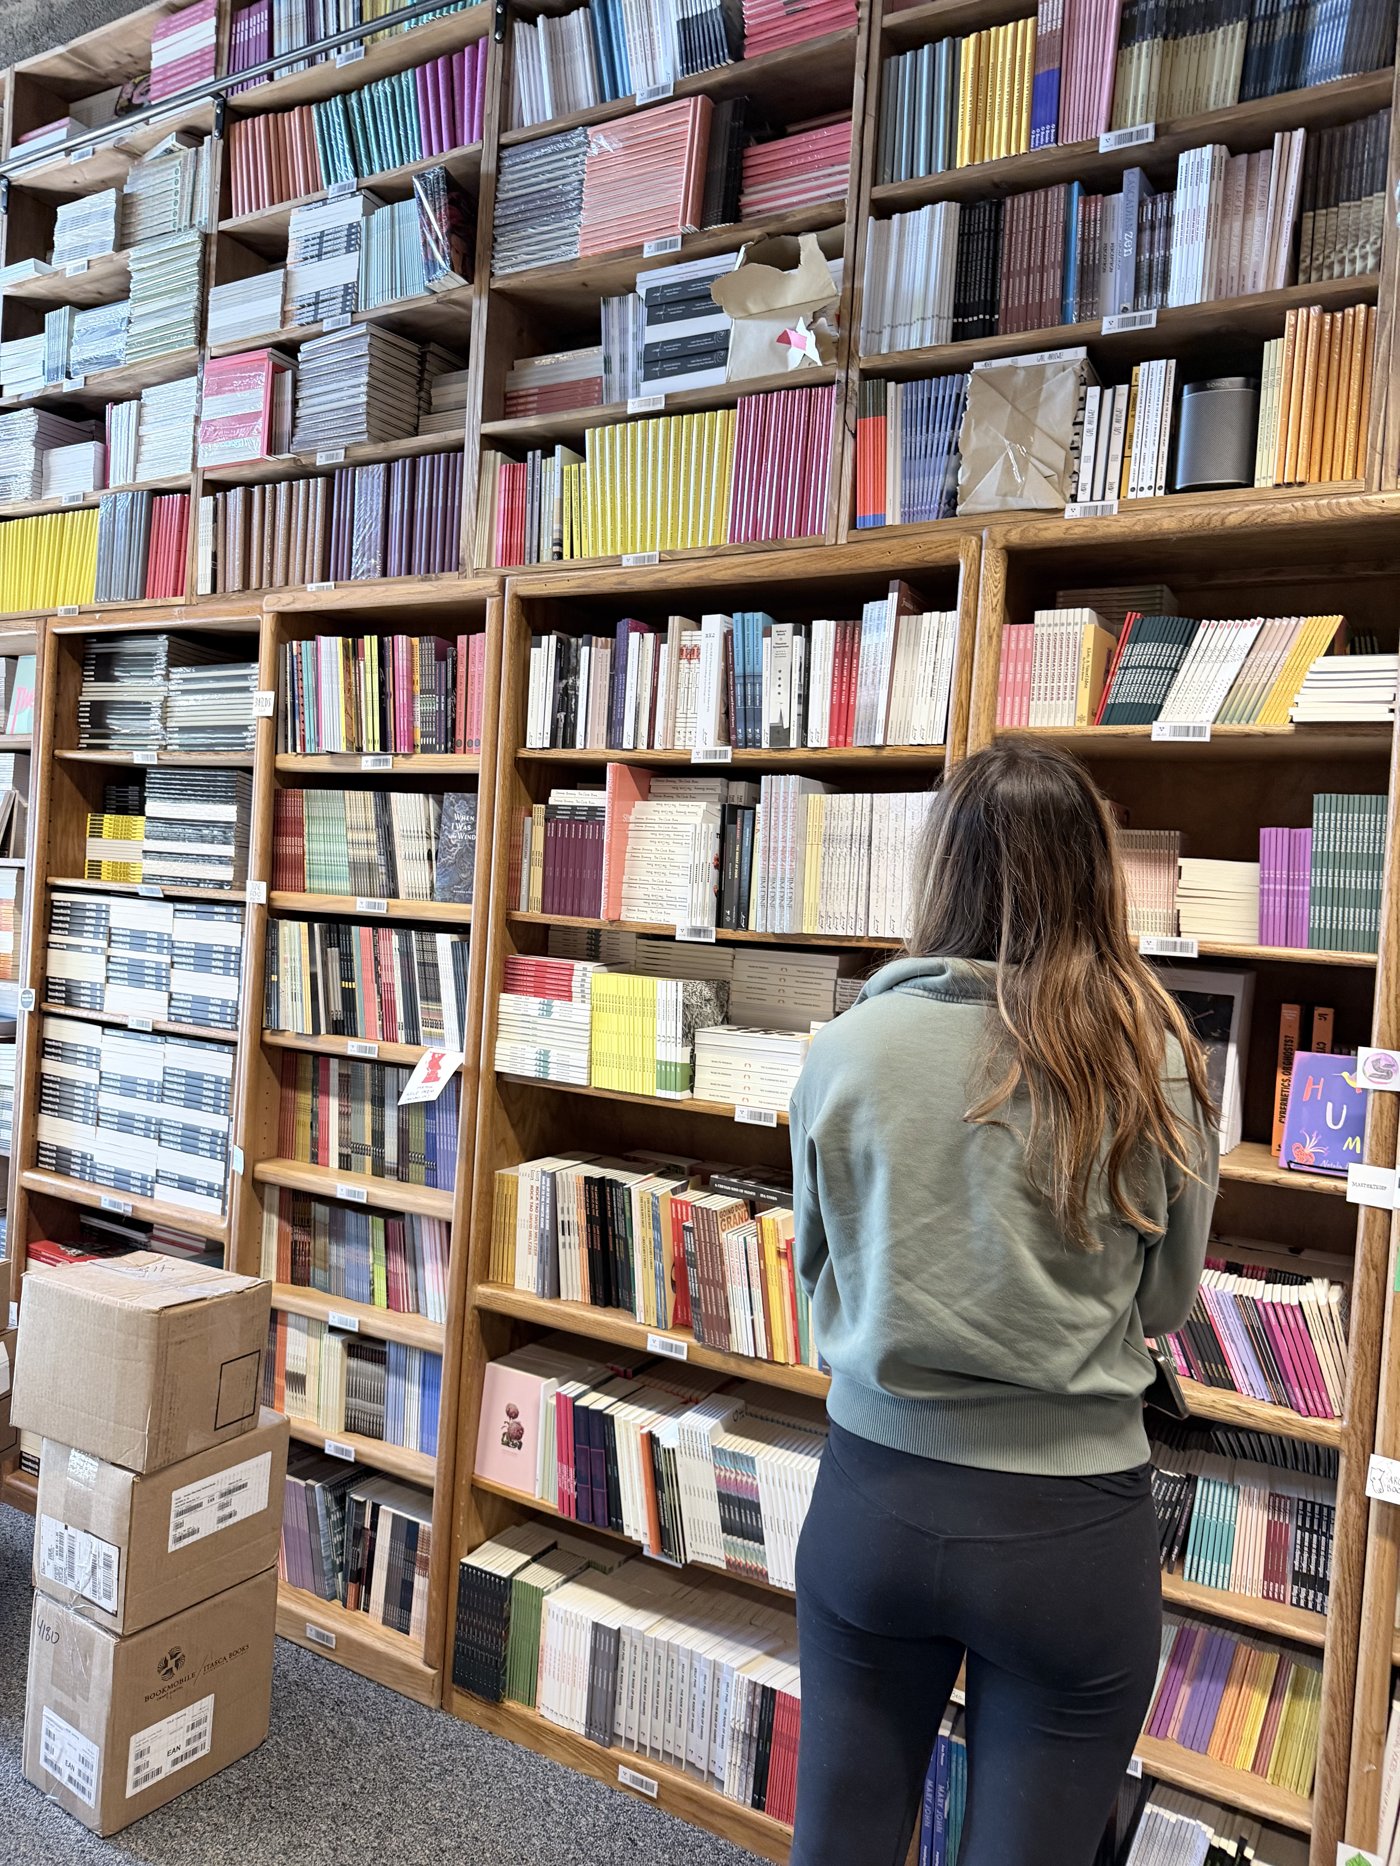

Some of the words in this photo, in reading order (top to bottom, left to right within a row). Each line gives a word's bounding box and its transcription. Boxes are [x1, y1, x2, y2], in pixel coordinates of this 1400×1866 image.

[1126, 171, 1136, 230] CASCADIAN
[1124, 232, 1133, 257] zen
[1206, 381, 1230, 389] SONOS
[454, 813, 475, 821] WHEN
[719, 1205, 735, 1218] GOING
[720, 1209, 750, 1232] GRAND
[144, 1672, 196, 1702] BOOKMOBILE
[203, 1656, 227, 1672] ITASCA
[228, 1644, 249, 1659] BOOKS
[167, 1744, 181, 1757] EAN
[65, 1759, 75, 1771] EAN
